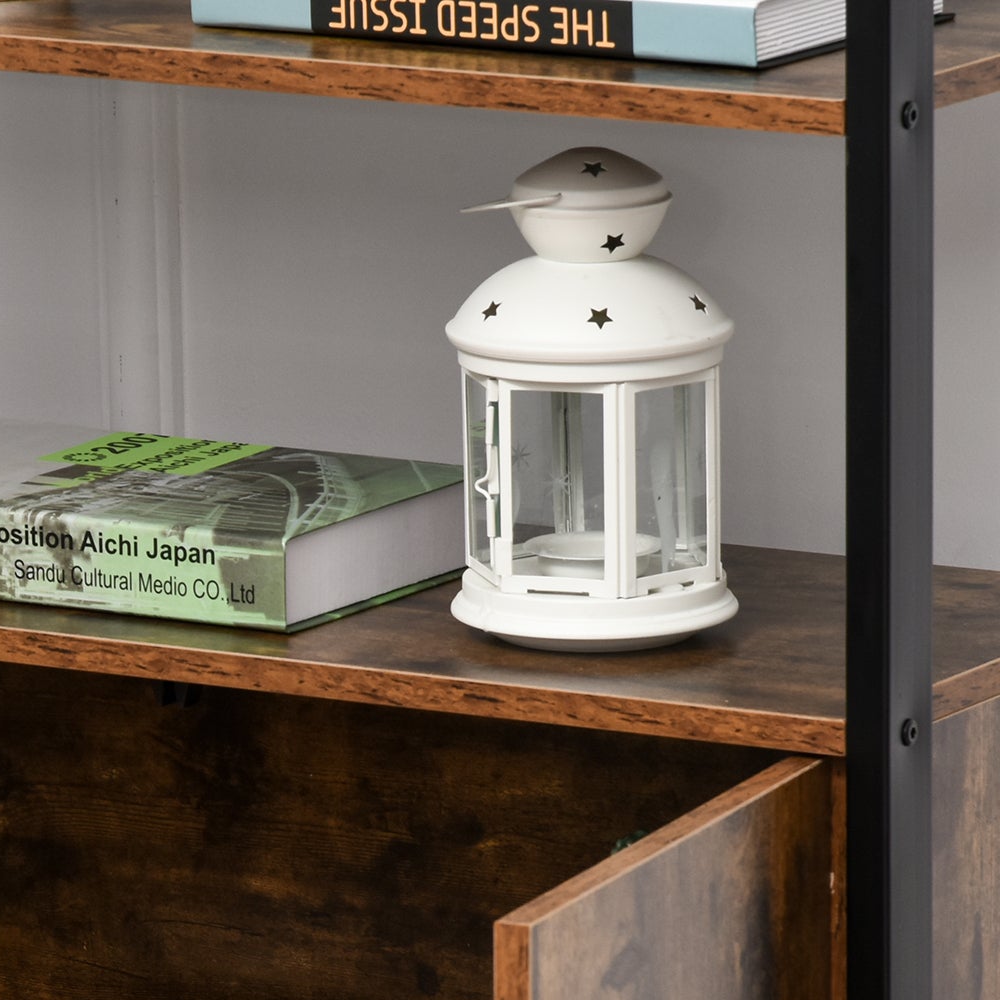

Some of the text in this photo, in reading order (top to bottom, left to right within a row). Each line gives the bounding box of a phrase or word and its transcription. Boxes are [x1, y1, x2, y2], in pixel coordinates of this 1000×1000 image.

[329, 0, 615, 48] THE SPEED ISSUE
[81, 530, 139, 557] Aichi
[146, 537, 216, 567] Japan
[14, 558, 66, 584] Sandu
[71, 565, 133, 592] Cultural
[138, 572, 188, 597] Medio
